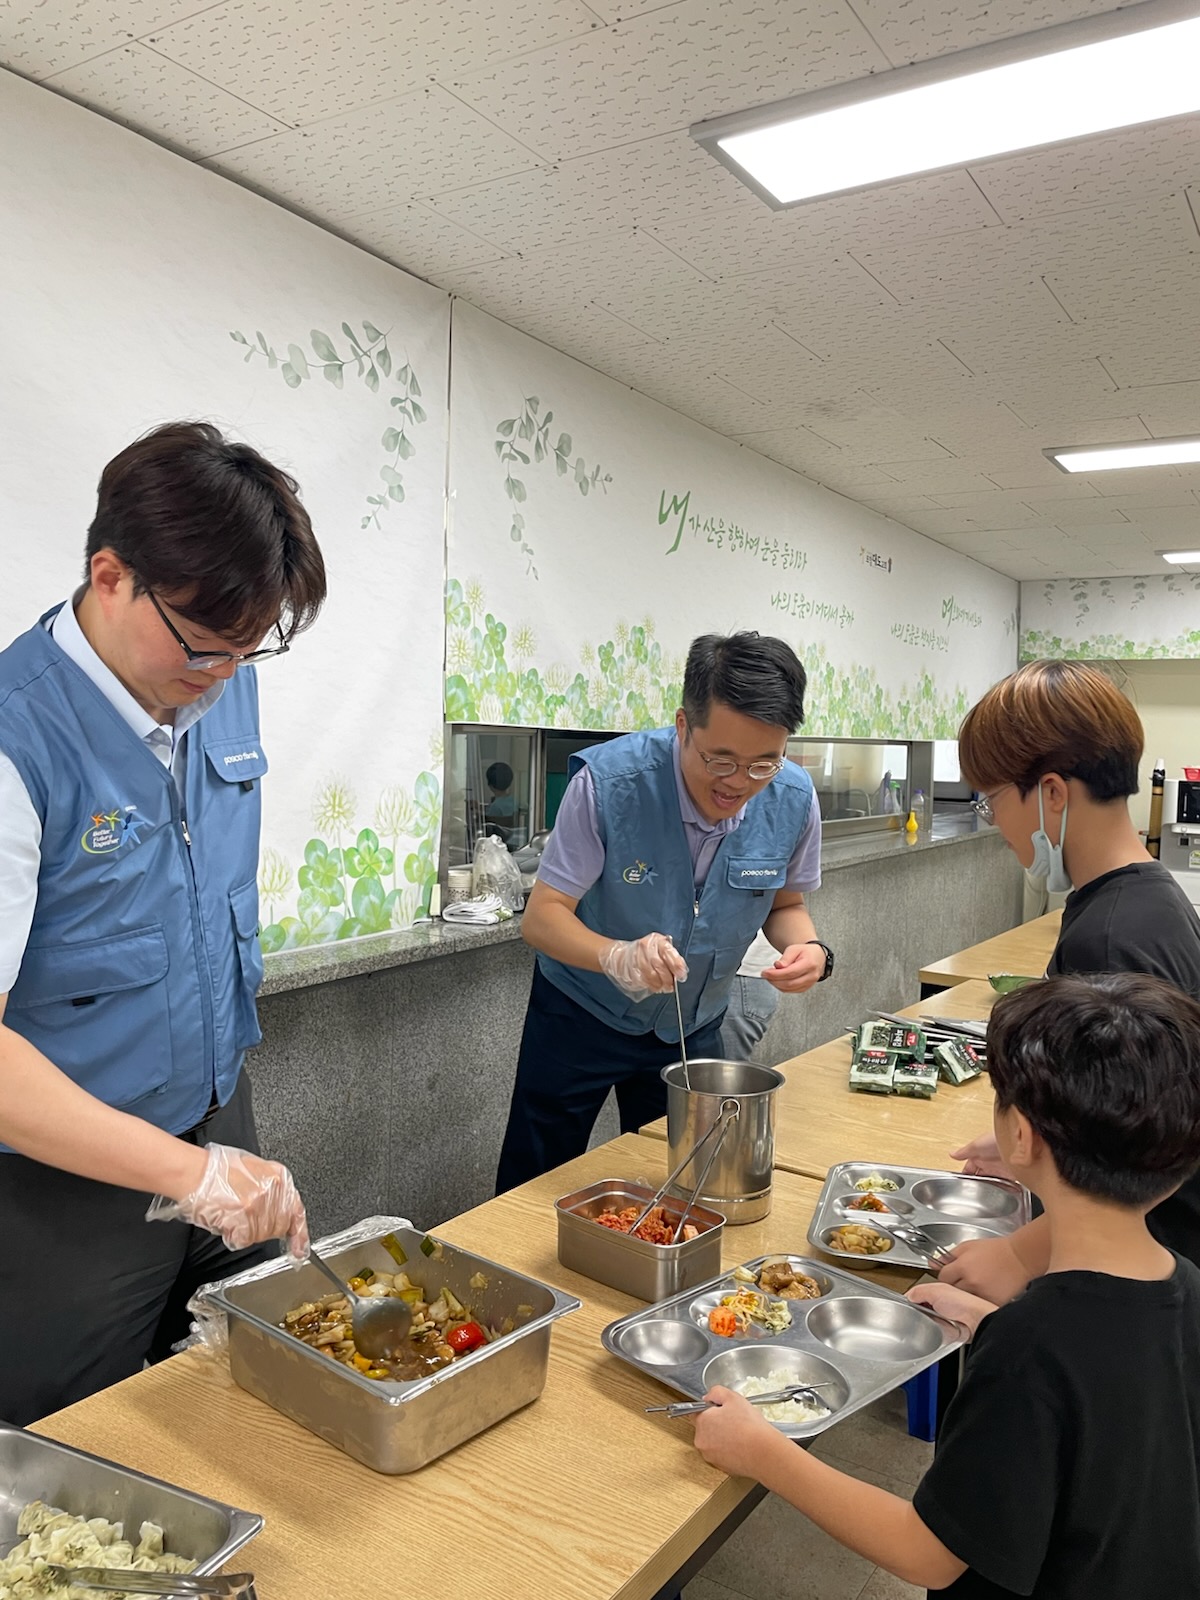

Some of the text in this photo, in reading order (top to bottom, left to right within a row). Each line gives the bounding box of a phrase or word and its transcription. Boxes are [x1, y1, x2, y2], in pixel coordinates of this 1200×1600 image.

[703, 517, 726, 549] 산을
[728, 523, 760, 557] 향하여
[761, 537, 780, 567] 눈을
[771, 590, 791, 613] 나의
[791, 592, 815, 620] 도움이
